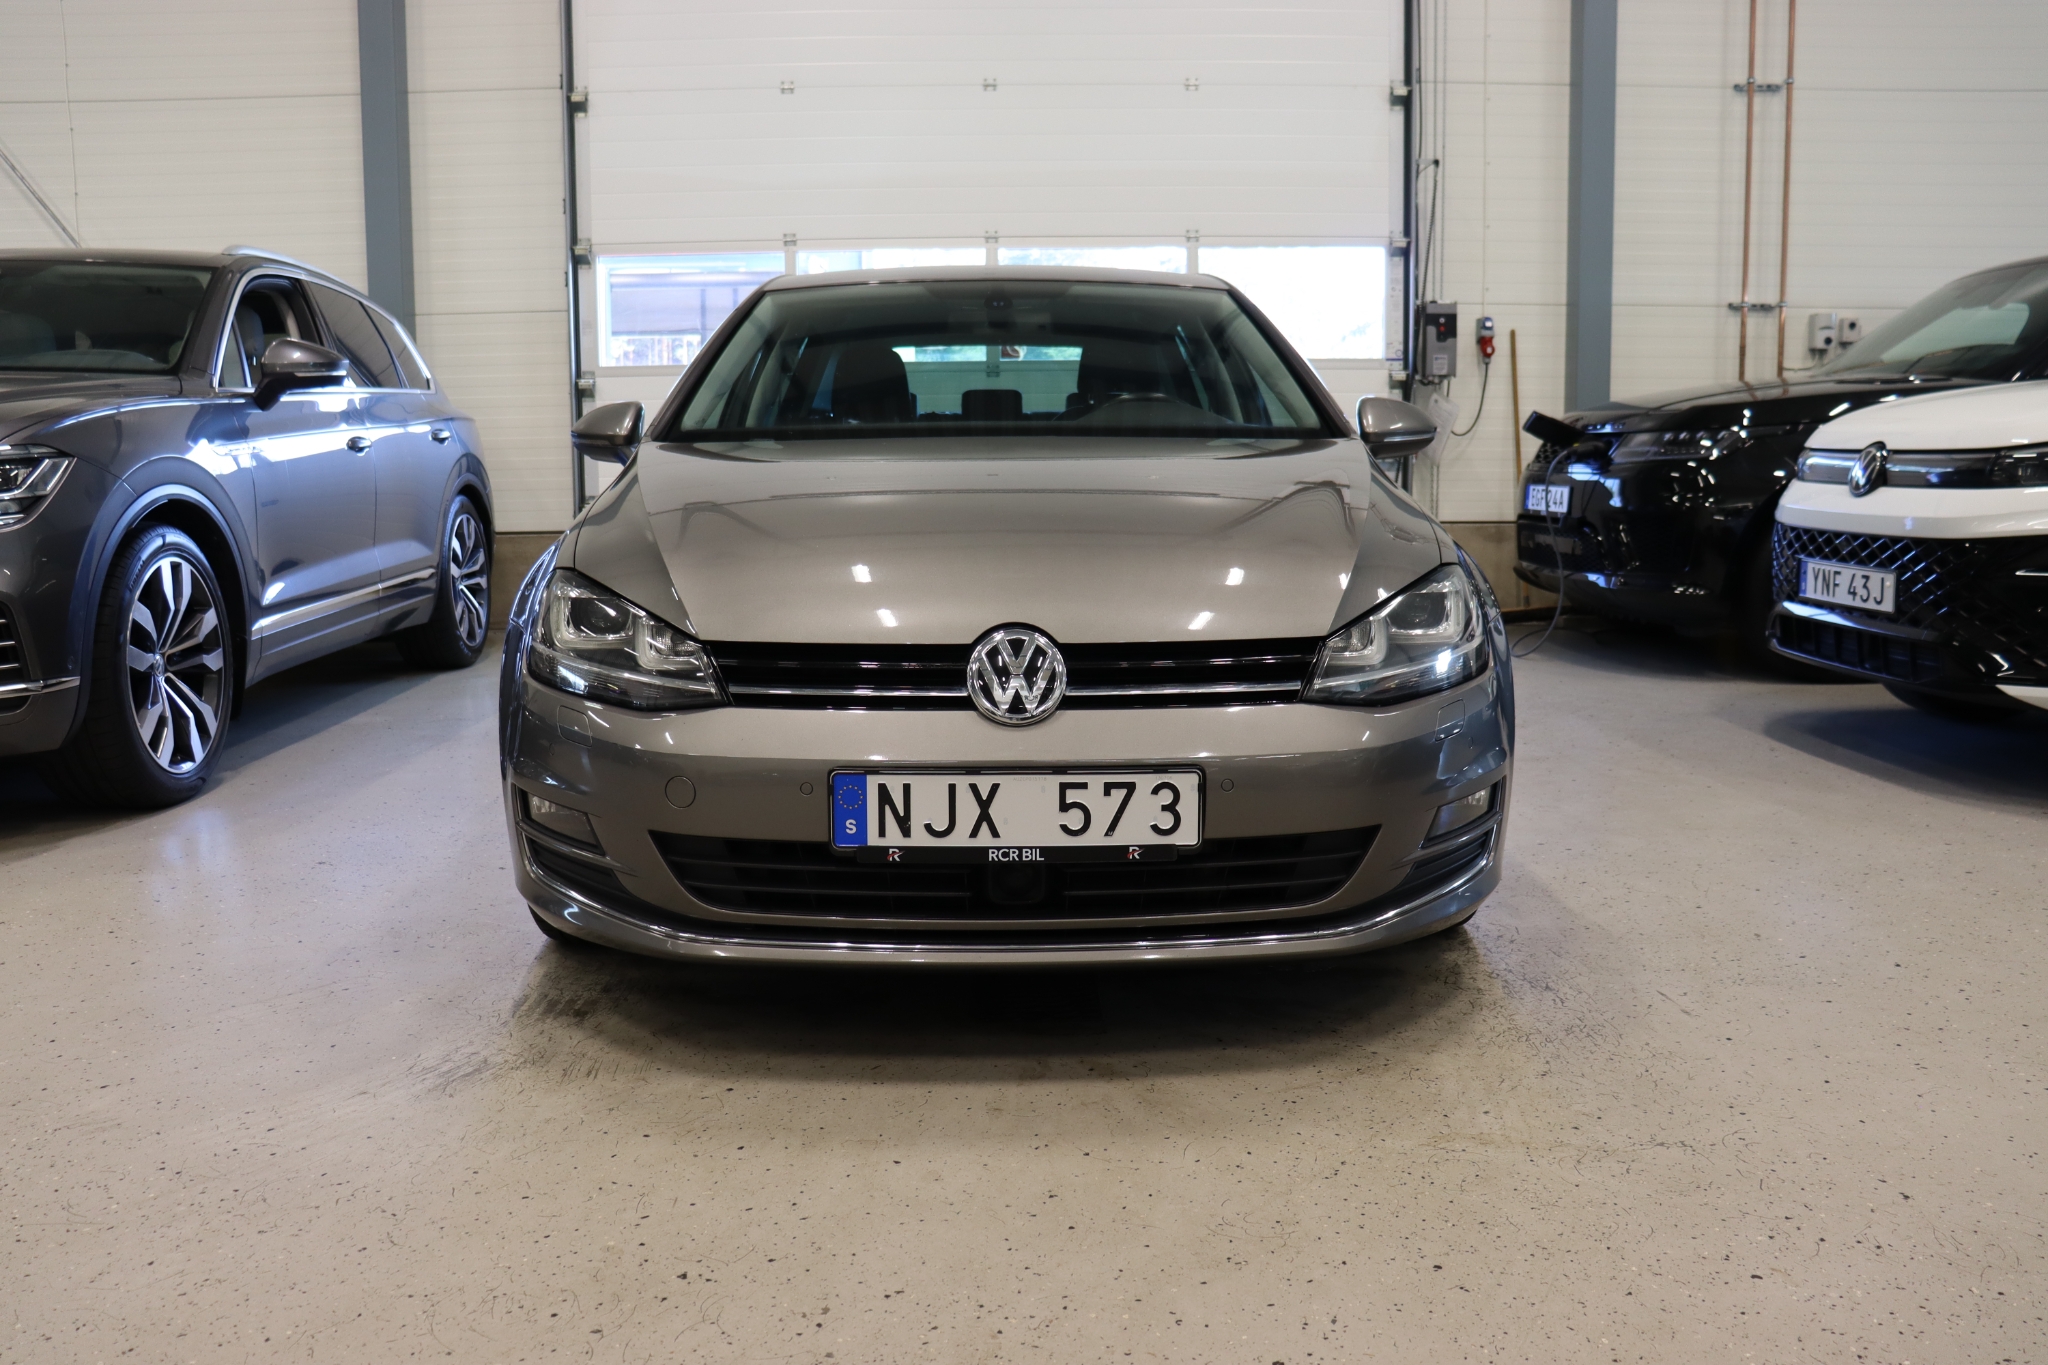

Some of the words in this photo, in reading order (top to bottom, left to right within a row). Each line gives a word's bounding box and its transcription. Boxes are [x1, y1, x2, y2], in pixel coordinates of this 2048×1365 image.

[1812, 566, 1841, 598] YNF
[1847, 572, 1884, 605] 43J
[971, 630, 1062, 720] VW
[845, 819, 857, 834] S
[877, 782, 1001, 839] NJX
[1058, 781, 1182, 837] 573
[988, 848, 1020, 862] RCR
[1022, 848, 1045, 861] BIL
